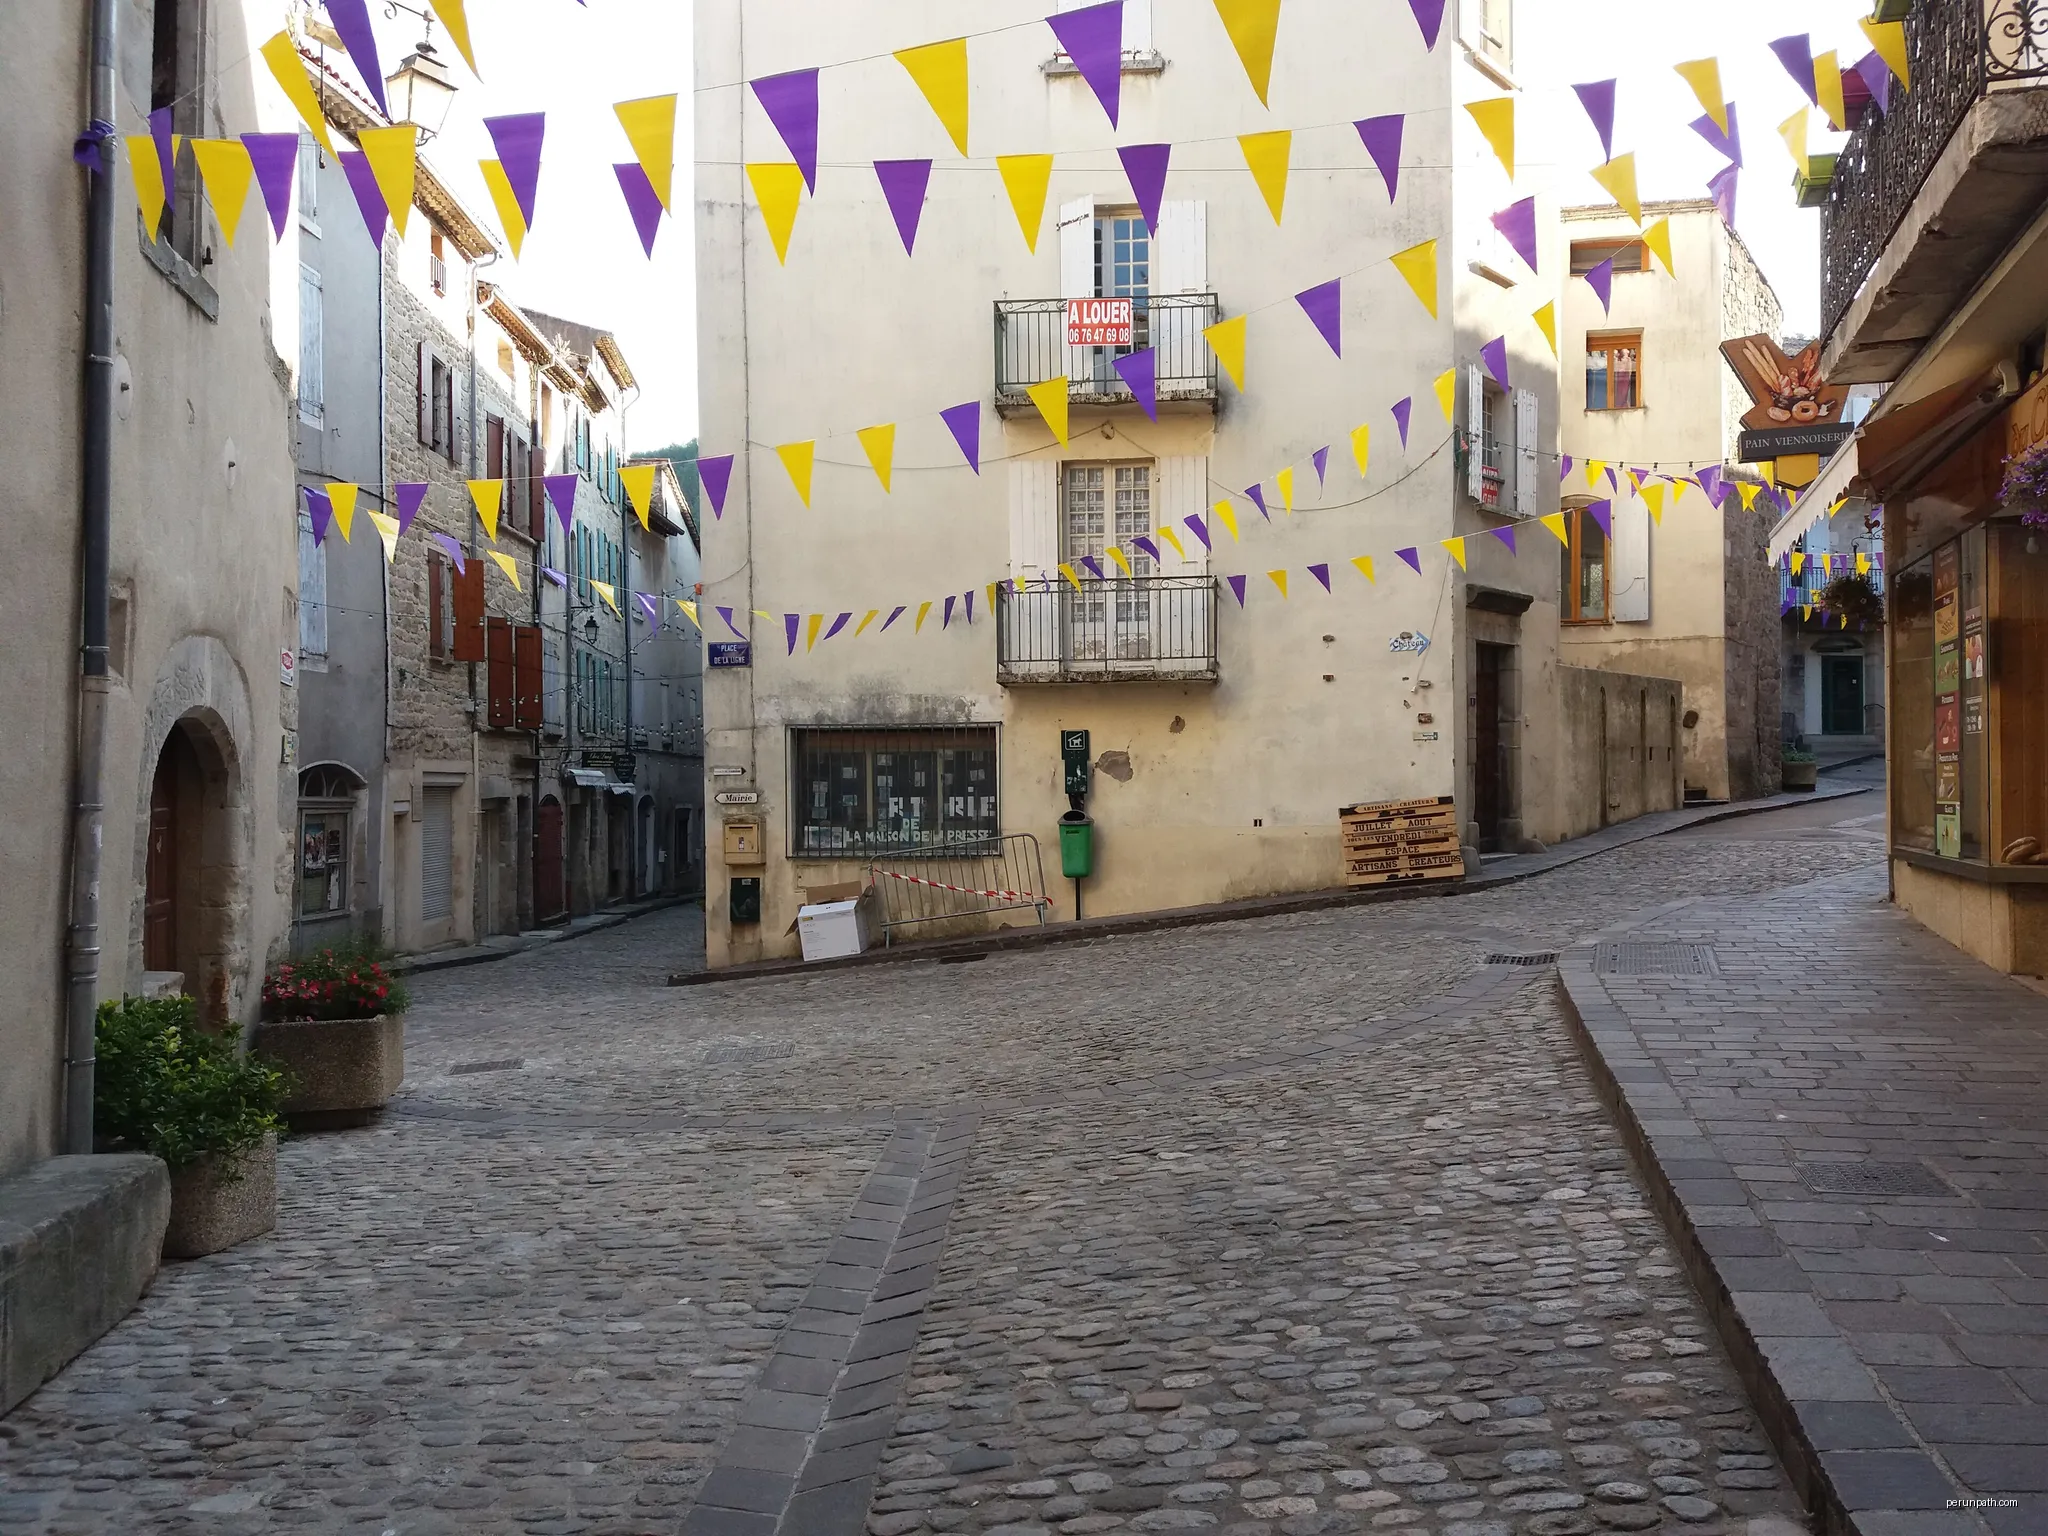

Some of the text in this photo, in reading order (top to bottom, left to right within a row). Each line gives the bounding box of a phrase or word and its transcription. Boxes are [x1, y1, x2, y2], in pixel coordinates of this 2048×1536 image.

[1069, 302, 1129, 324] A LOUER
[1069, 328, 1130, 343] 06 76 47 69 08
[1745, 431, 1851, 449] PAIN VIENNOISERIE
[720, 644, 738, 652] PLACE
[731, 656, 746, 664] LIGNE
[725, 794, 753, 802] Mairie
[902, 817, 920, 830] DE
[1353, 821, 1393, 832] JUILLET
[846, 830, 861, 842] LA
[865, 829, 909, 843] MAISON
[912, 830, 930, 842] DE
[947, 829, 990, 842] PRESSE
[1375, 832, 1422, 843] VENDREDI
[1384, 845, 1420, 856] ESPACE
[1351, 854, 1461, 872] ARTISANS CREATEURS
